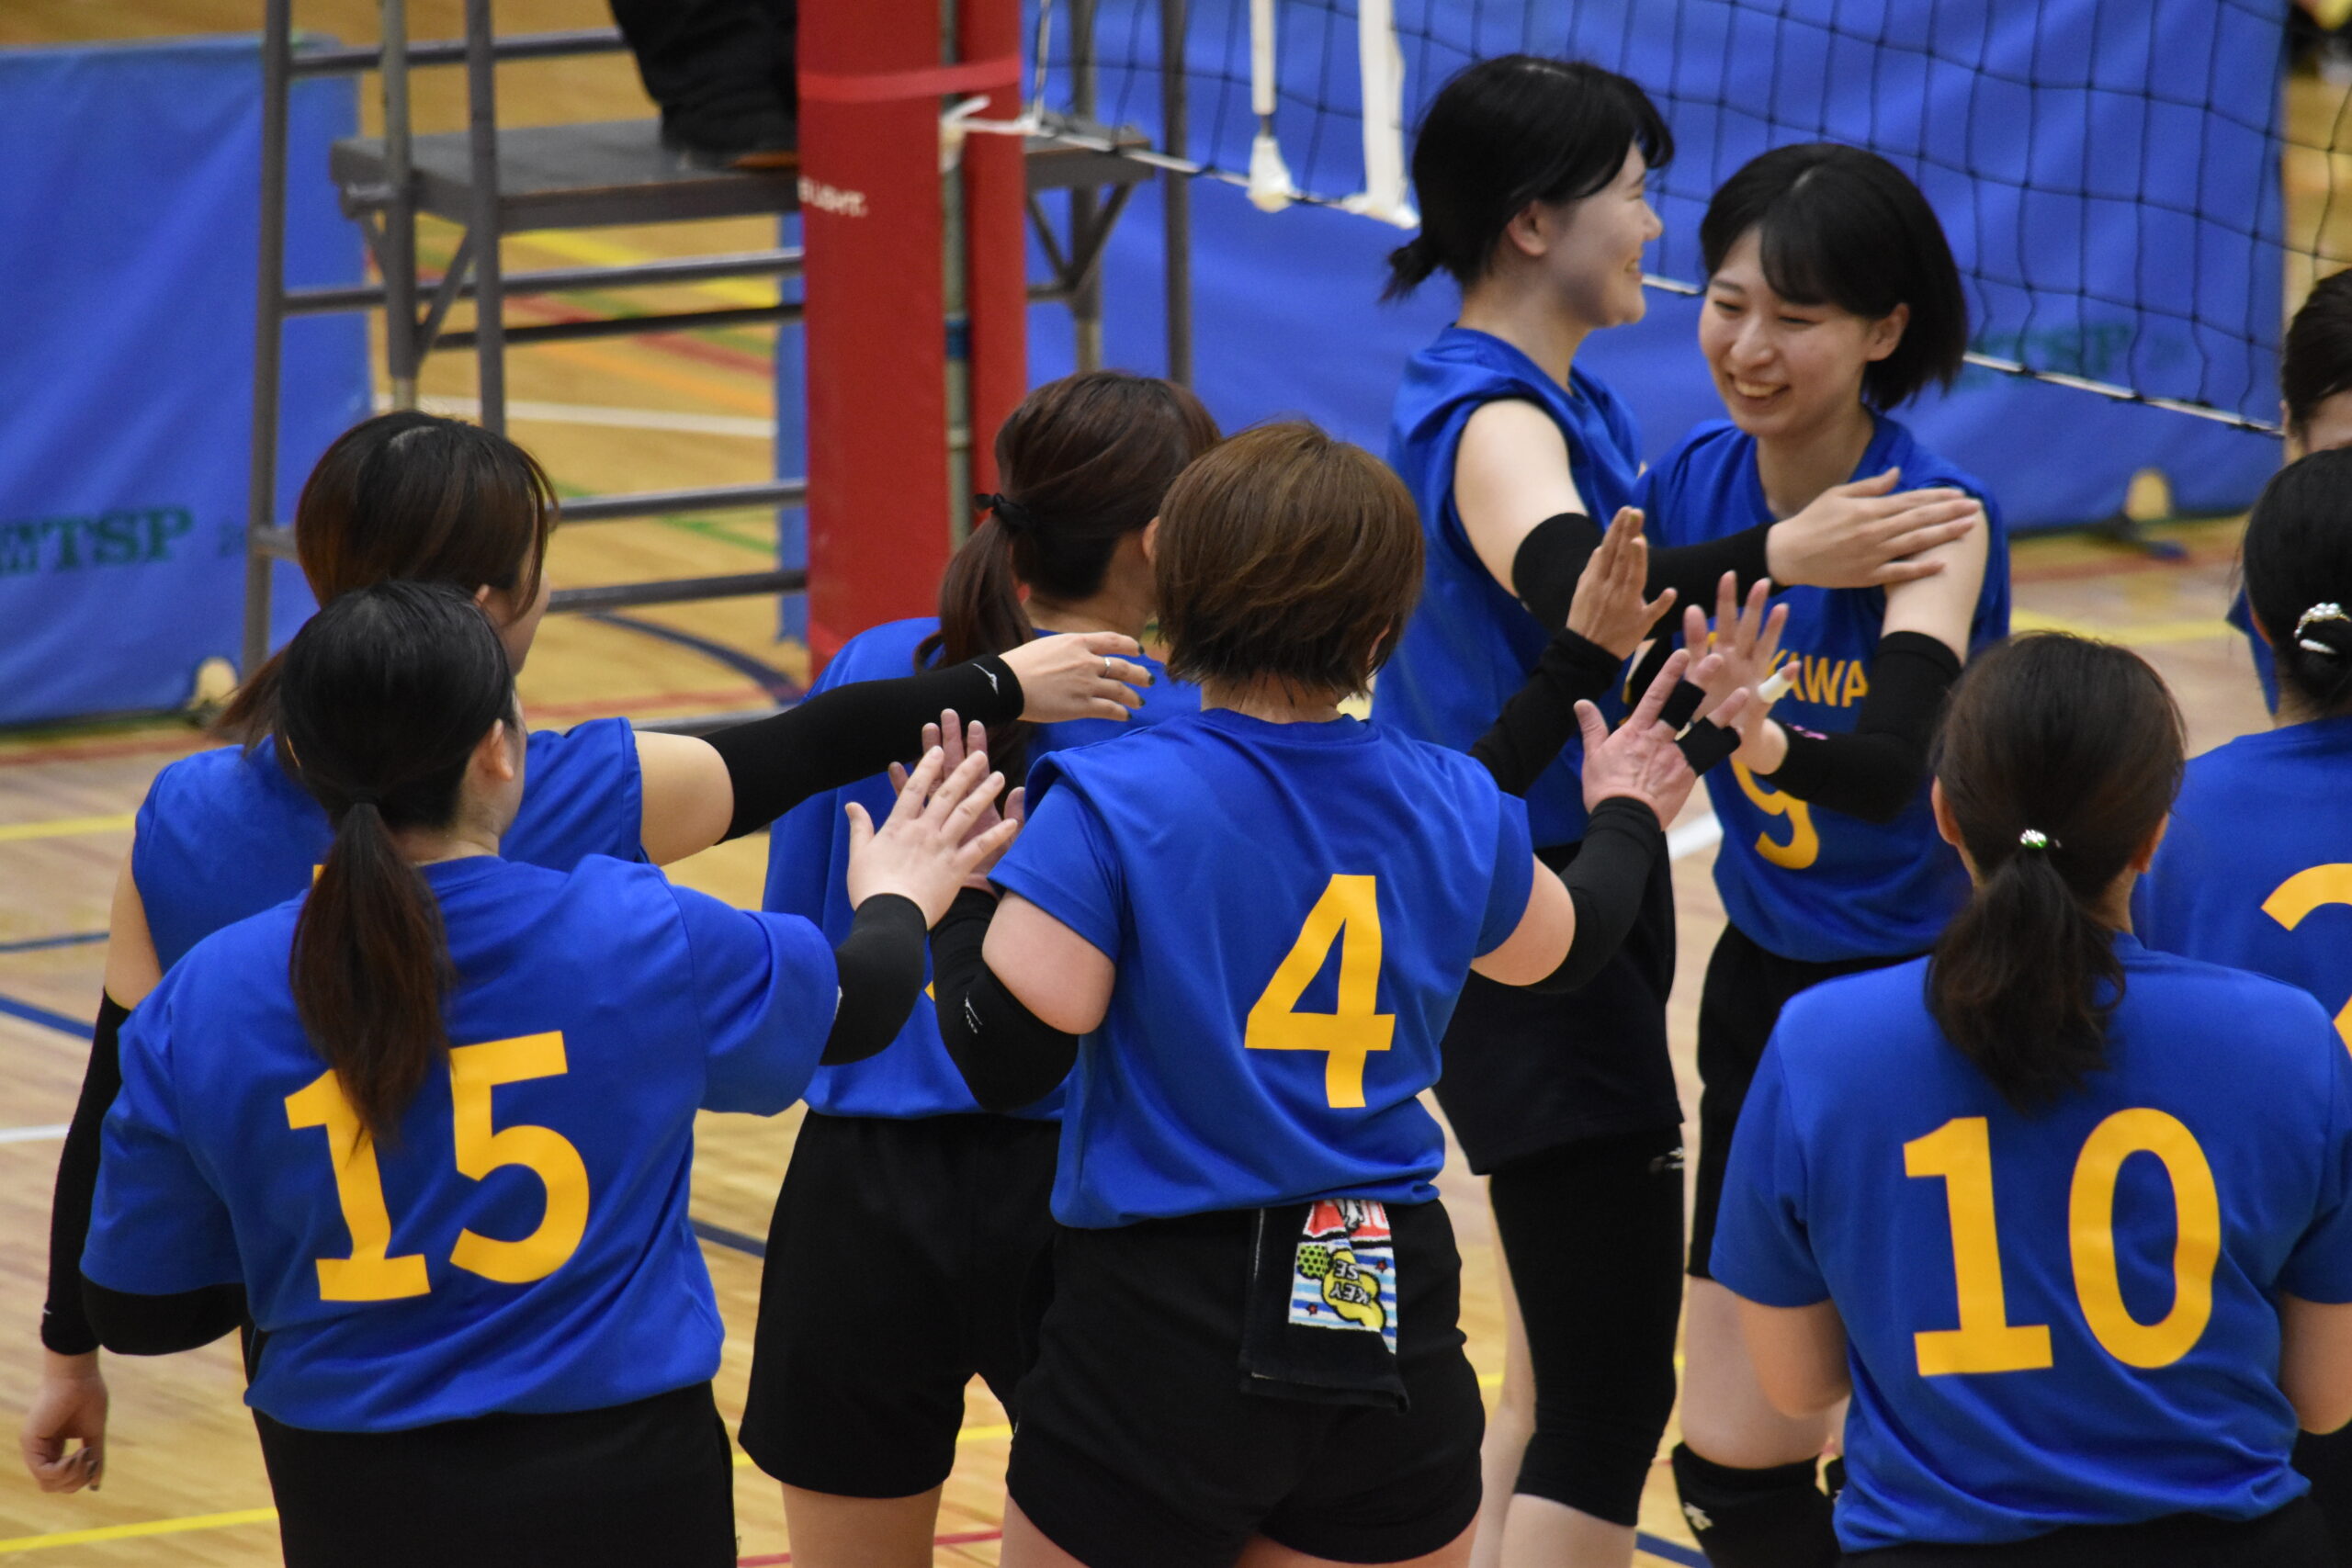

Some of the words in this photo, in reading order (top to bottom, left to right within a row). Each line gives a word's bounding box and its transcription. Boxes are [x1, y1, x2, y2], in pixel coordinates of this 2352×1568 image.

[1244, 874, 1396, 1108] 4
[284, 1030, 590, 1302] 15
[1904, 1108, 2221, 1377] 10
